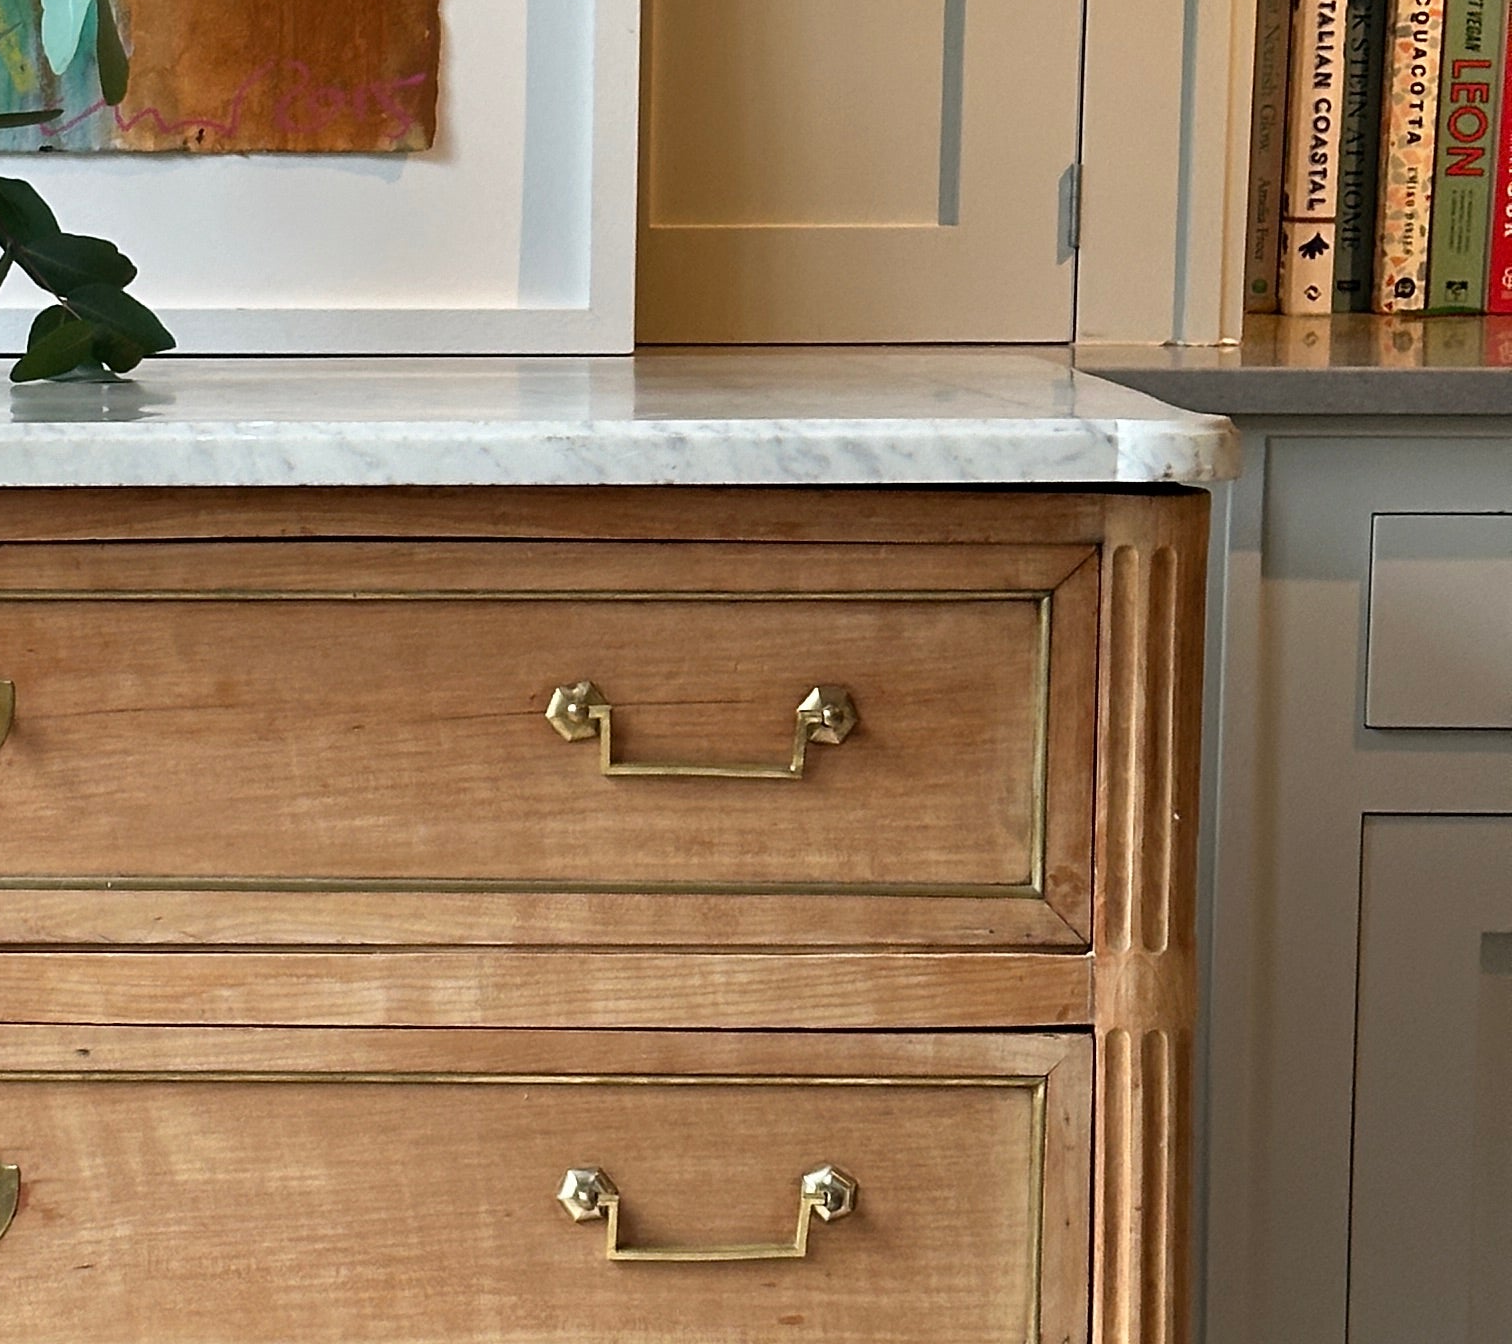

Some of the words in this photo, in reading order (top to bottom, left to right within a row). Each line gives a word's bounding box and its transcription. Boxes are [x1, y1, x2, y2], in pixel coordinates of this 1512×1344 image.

[1464, 10, 1484, 54] VEGAN
[1347, 38, 1370, 119] STEIN
[1445, 59, 1492, 178] LEON
[1307, 98, 1333, 211] COASTAL
[1345, 127, 1365, 162] AT
[1341, 169, 1364, 251] HOME
